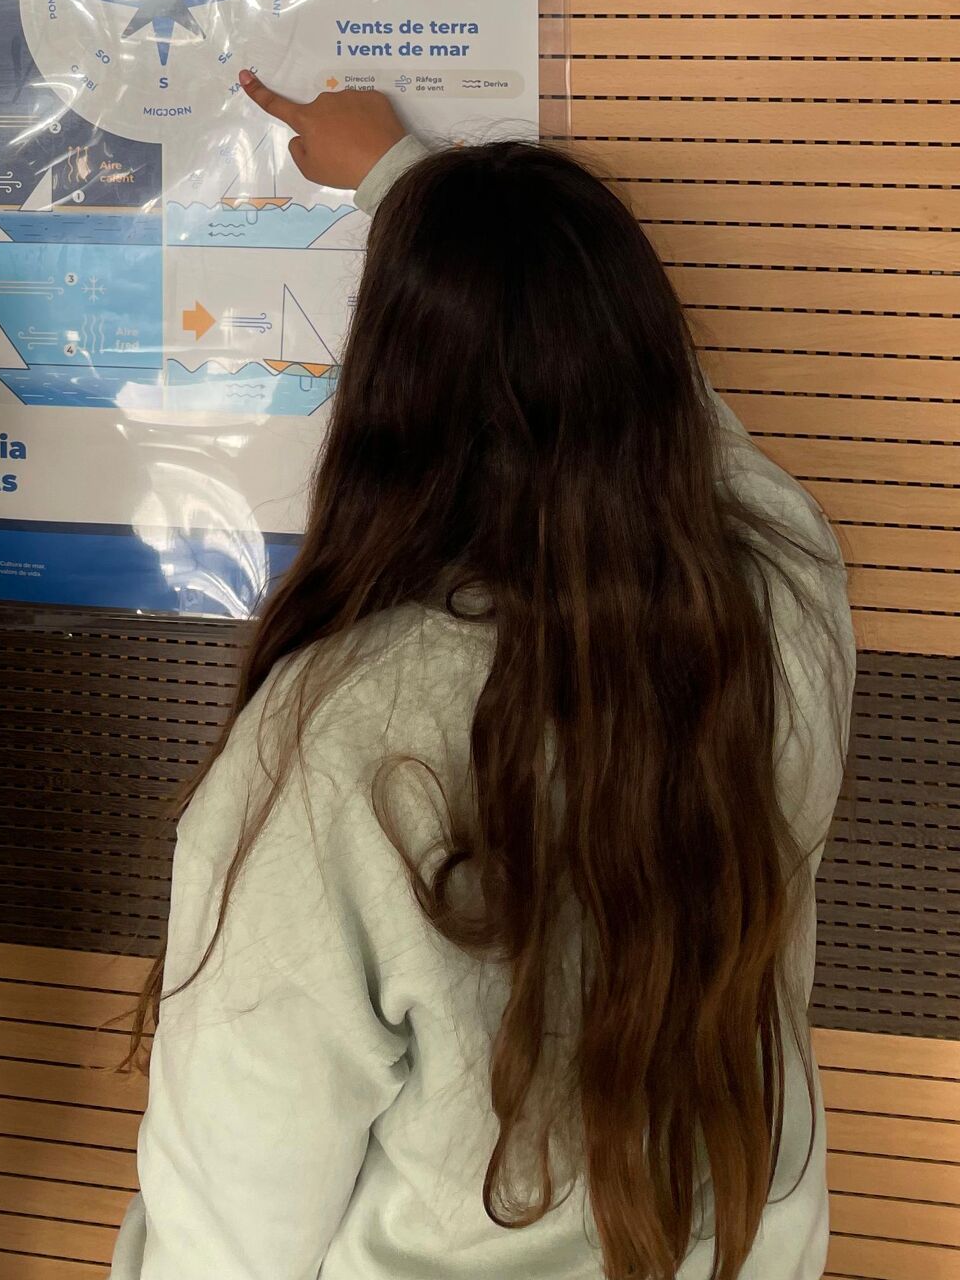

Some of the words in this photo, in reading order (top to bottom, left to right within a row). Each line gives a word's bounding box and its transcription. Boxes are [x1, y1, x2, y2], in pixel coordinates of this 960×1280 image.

[336, 20, 393, 34] Vents
[399, 20, 424, 34] de
[430, 21, 479, 34] terra
[337, 41, 341, 55] i
[348, 44, 392, 56] vent
[398, 42, 423, 56] de
[430, 44, 469, 56] mar
[95, 49, 111, 64] SO
[71, 64, 97, 91] GRBÍ
[159, 77, 168, 88] S
[229, 66, 258, 95] XAC
[416, 76, 442, 84] Ràfega
[143, 106, 192, 117] MIGJORN
[100, 161, 122, 170] Aire
